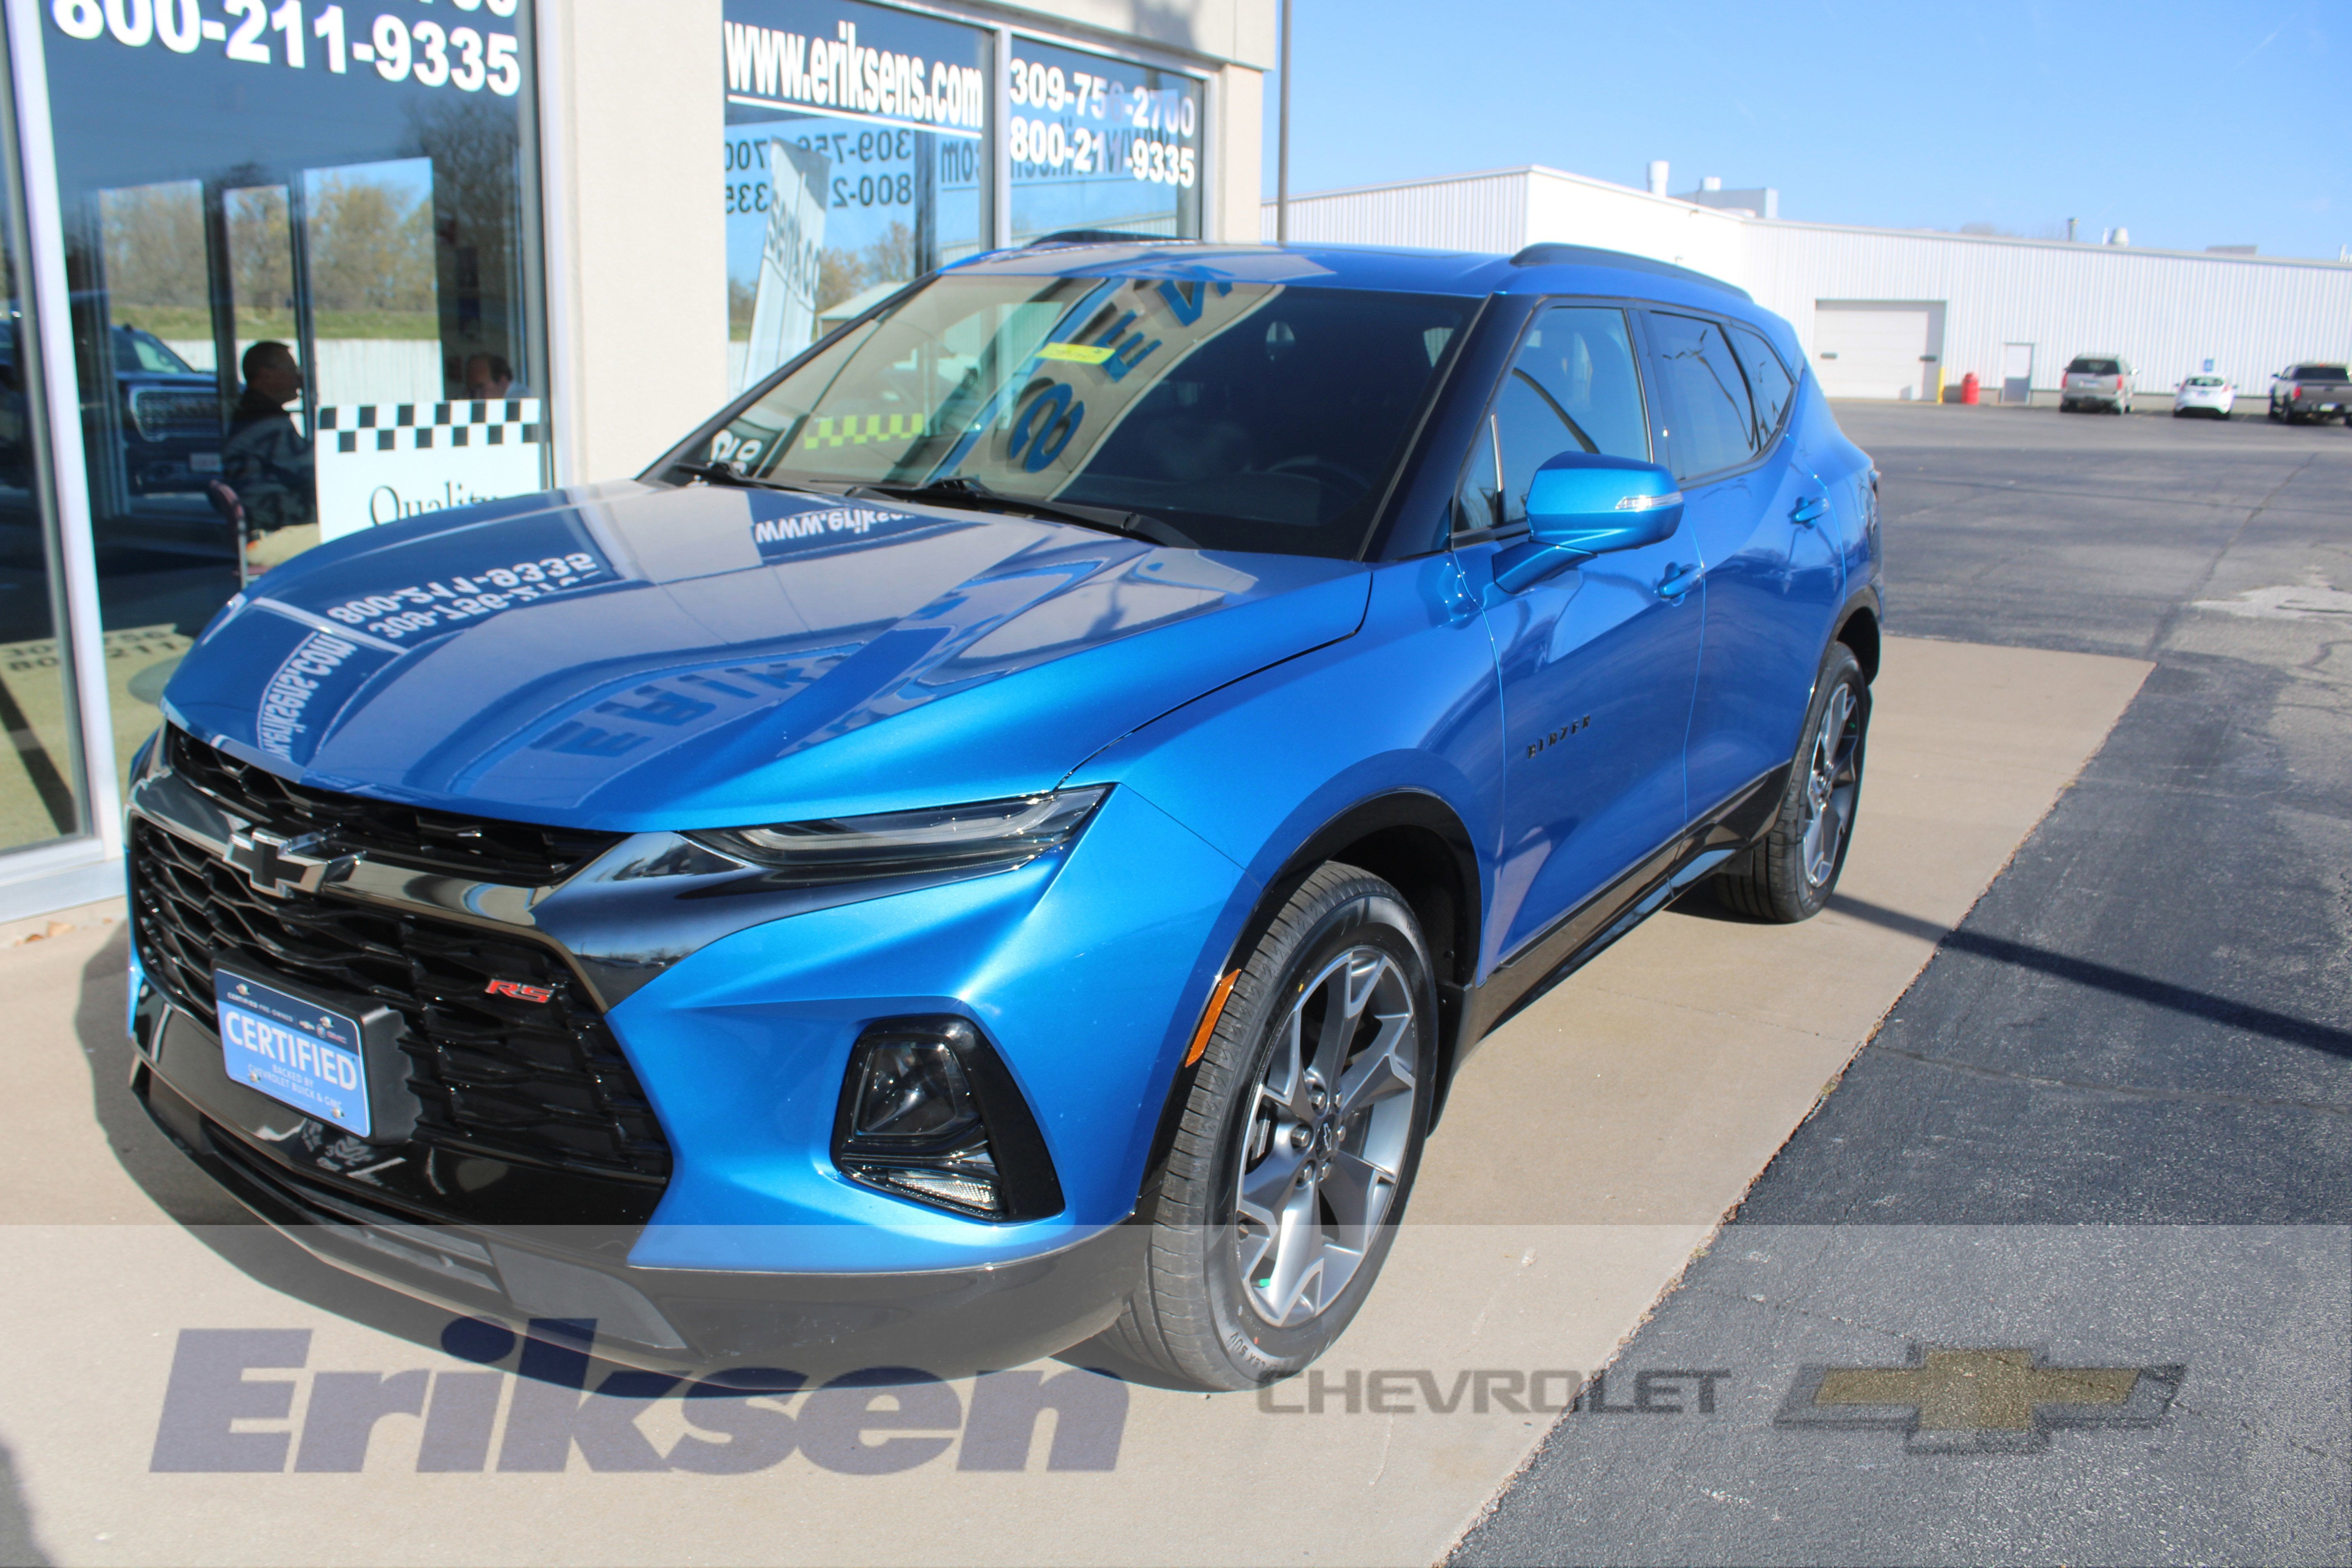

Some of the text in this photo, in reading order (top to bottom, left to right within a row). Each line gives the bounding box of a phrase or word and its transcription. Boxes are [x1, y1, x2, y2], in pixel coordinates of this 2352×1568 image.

[52, 0, 521, 96] 800-211-9335
[724, 21, 983, 127] www.eriksens.com
[1009, 58, 1195, 138] 309-756-2700
[1009, 116, 1195, 188] 800-211-9335
[369, 480, 500, 527] Qualit
[1527, 715, 1590, 759] BLAZER
[485, 979, 554, 1003] RS
[225, 1011, 357, 1091] CERTIFIED
[272, 1064, 313, 1088] BACKED BY
[247, 1064, 290, 1088] CHEVROLET
[292, 1082, 315, 1099] BUICK
